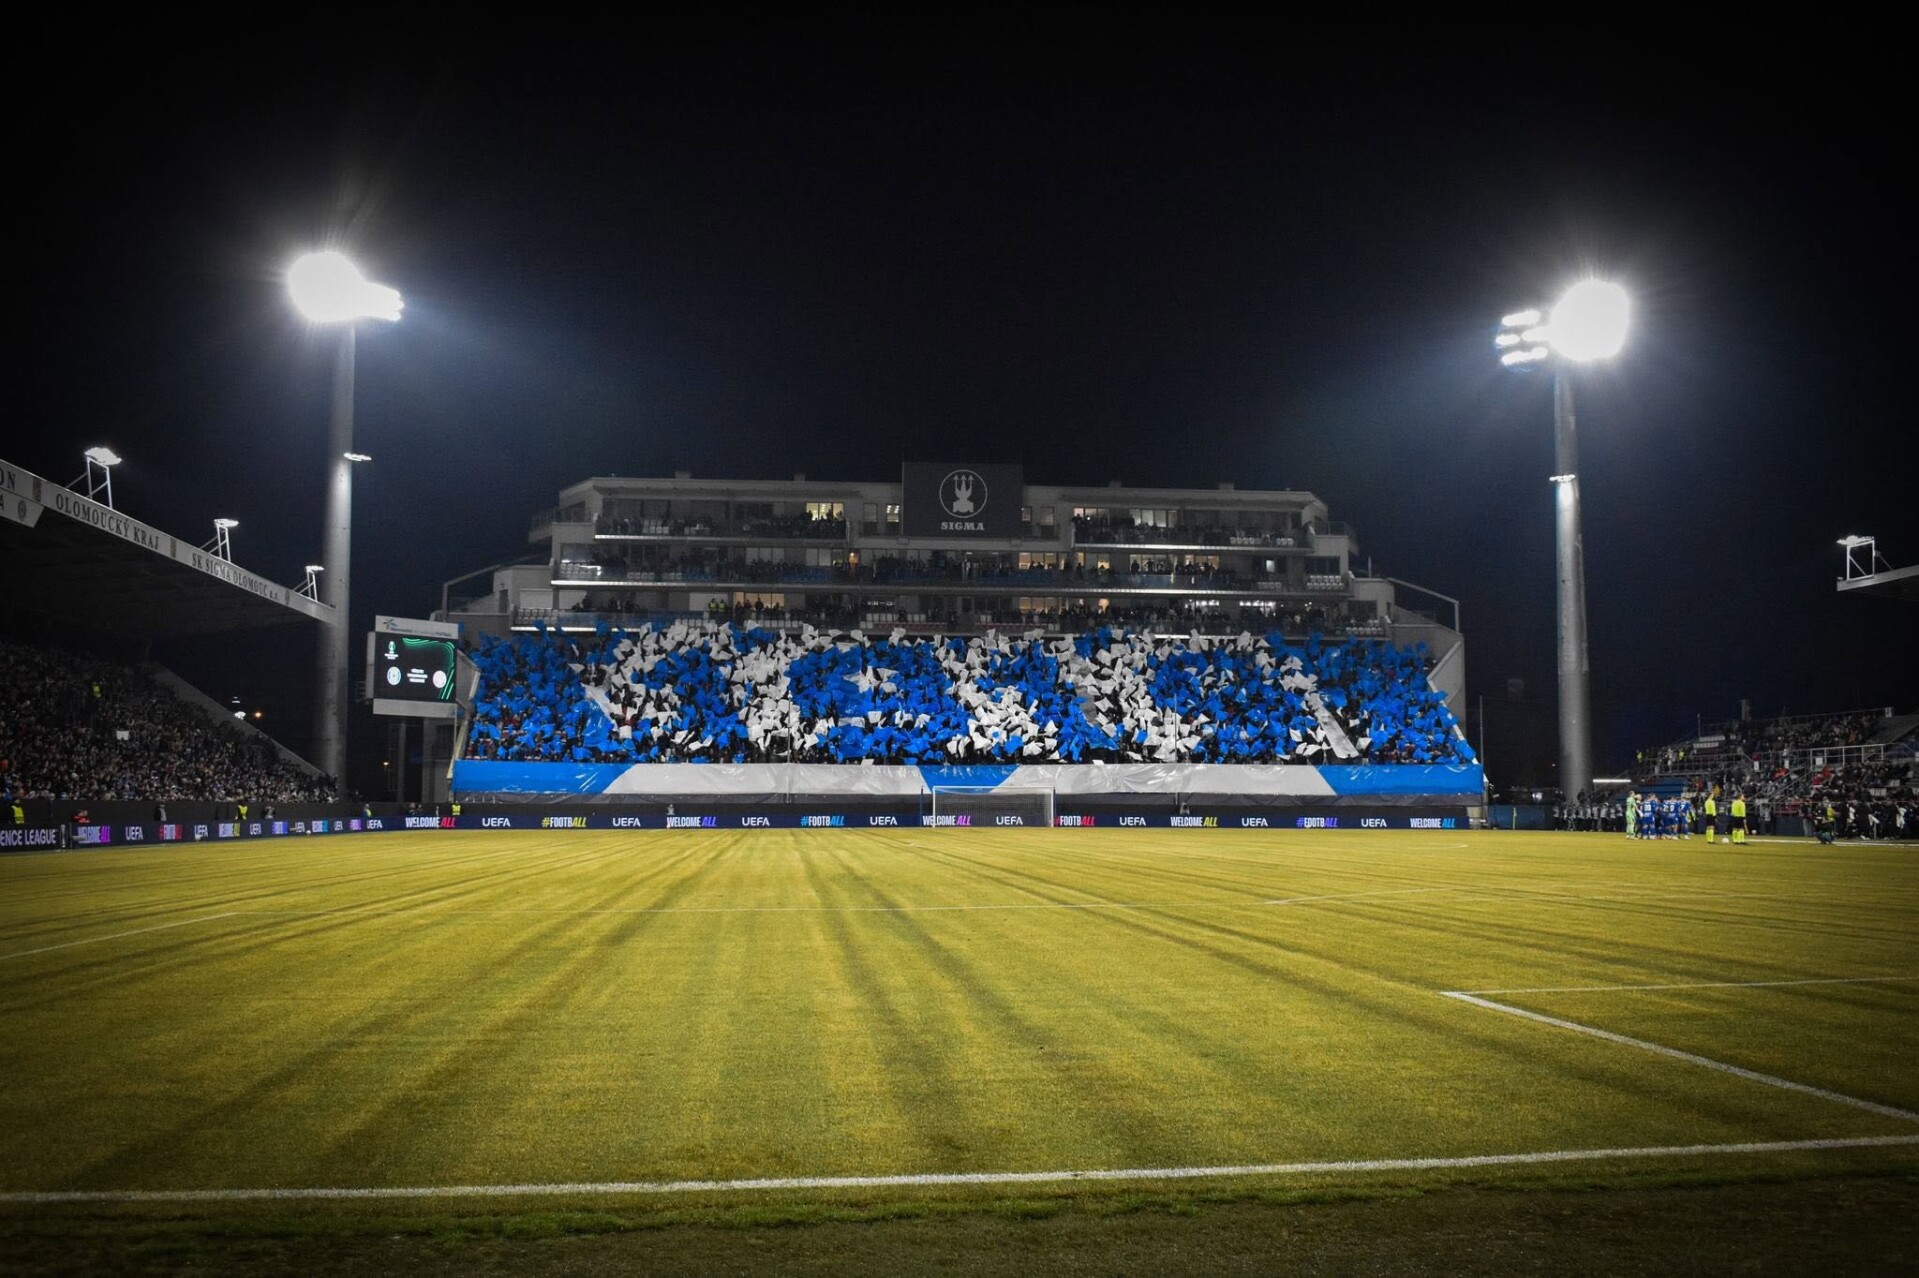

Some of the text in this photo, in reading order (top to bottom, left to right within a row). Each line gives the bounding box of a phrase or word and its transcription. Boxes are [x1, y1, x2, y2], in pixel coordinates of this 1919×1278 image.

[56, 493, 160, 550] OLOMOUCKÝ KRAJ
[941, 522, 984, 531] SIGMA
[192, 553, 203, 569] SK
[205, 559, 230, 581] SIGMA
[233, 571, 268, 596] OLOMOUC
[366, 819, 383, 829] UEFA
[405, 817, 456, 828] WELCOME ALL
[482, 817, 511, 827] UEFA
[542, 816, 587, 828] #FOOTBALL
[612, 817, 641, 827] UEFA
[667, 816, 717, 827] WELCOME ALL
[742, 816, 770, 827] UEFA
[800, 815, 845, 827] #FOOTBALL
[869, 816, 898, 826] UEFA
[956, 815, 971, 826] ALL
[996, 816, 1023, 826] UEFA
[1119, 816, 1146, 826] UEFA
[1170, 816, 1218, 827] WELCOME ALL
[1241, 817, 1268, 827] UEFA
[1296, 817, 1339, 828] #FOOTBALL
[1361, 818, 1387, 828] UEFA
[1410, 817, 1456, 829] WELCOME ALL
[24, 828, 57, 845] LEAGUE
[125, 826, 143, 840] UEFA
